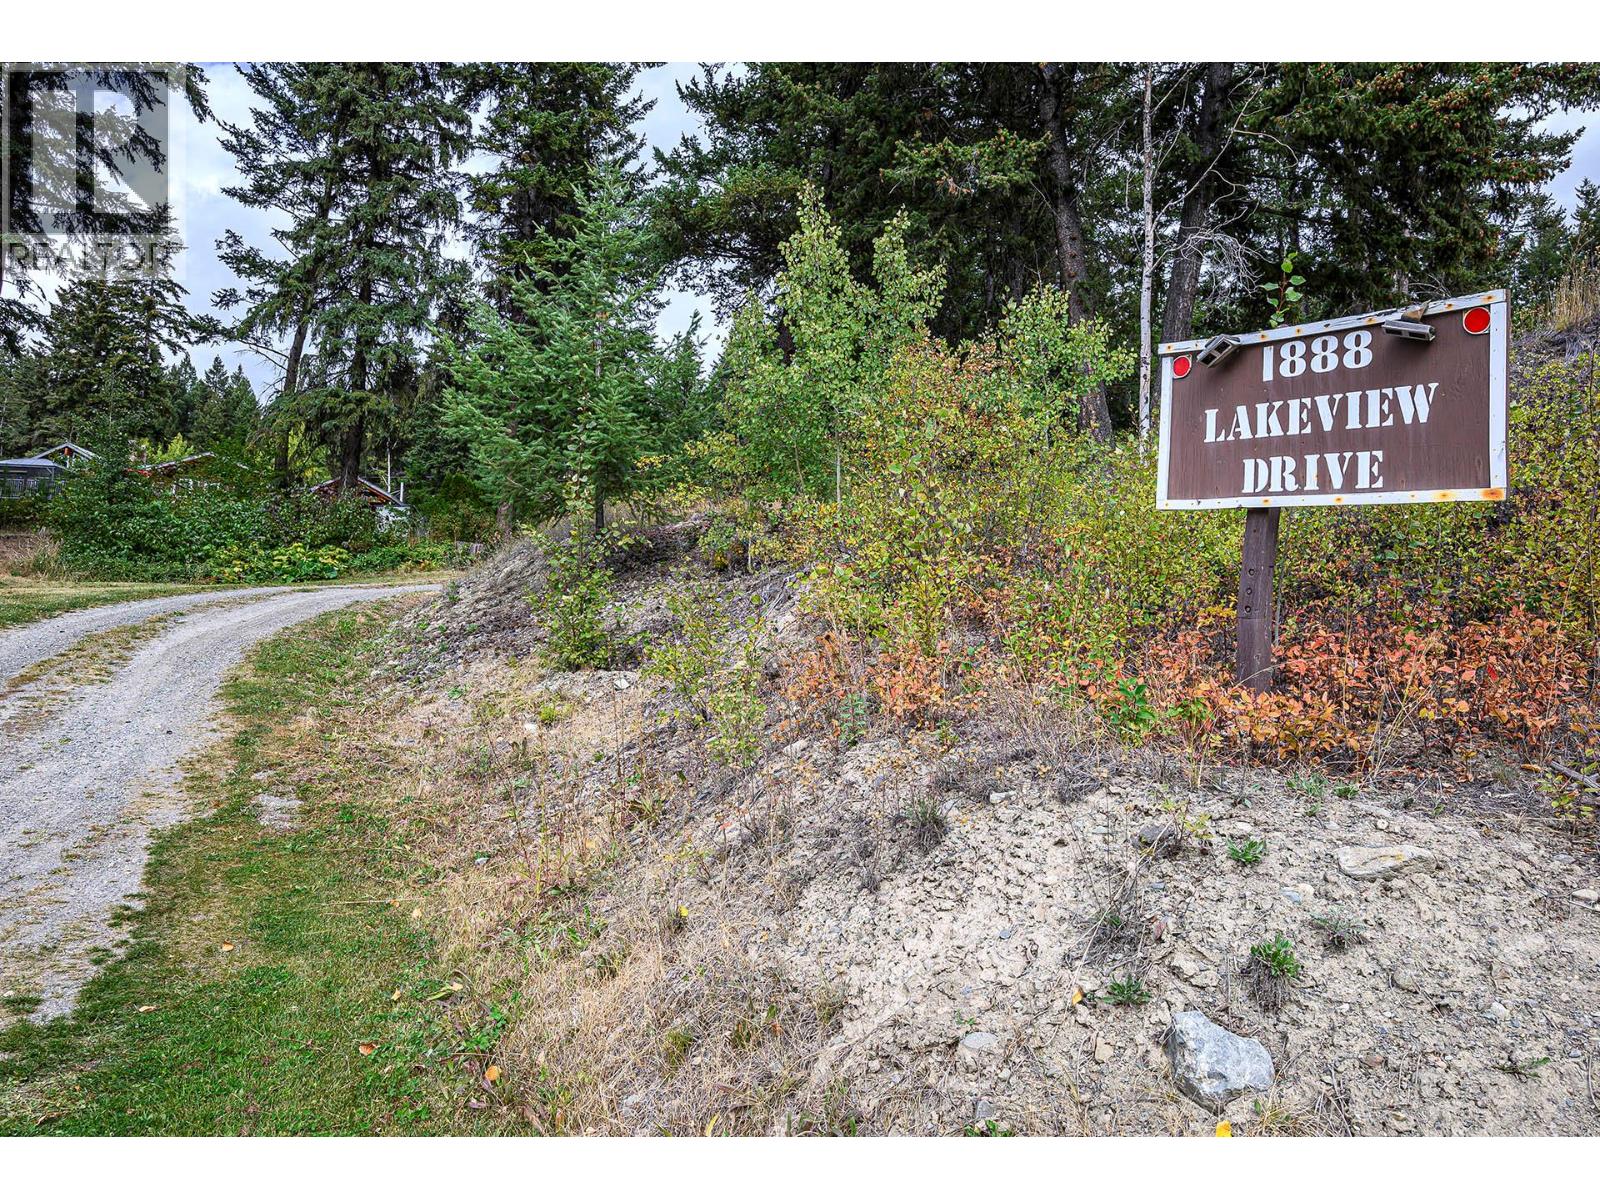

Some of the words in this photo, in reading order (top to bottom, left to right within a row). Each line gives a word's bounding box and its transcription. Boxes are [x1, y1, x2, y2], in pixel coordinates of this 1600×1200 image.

[1262, 330, 1373, 382] 1888
[1203, 382, 1439, 443] LAKEVIEW
[1241, 450, 1384, 493] DRIVE
